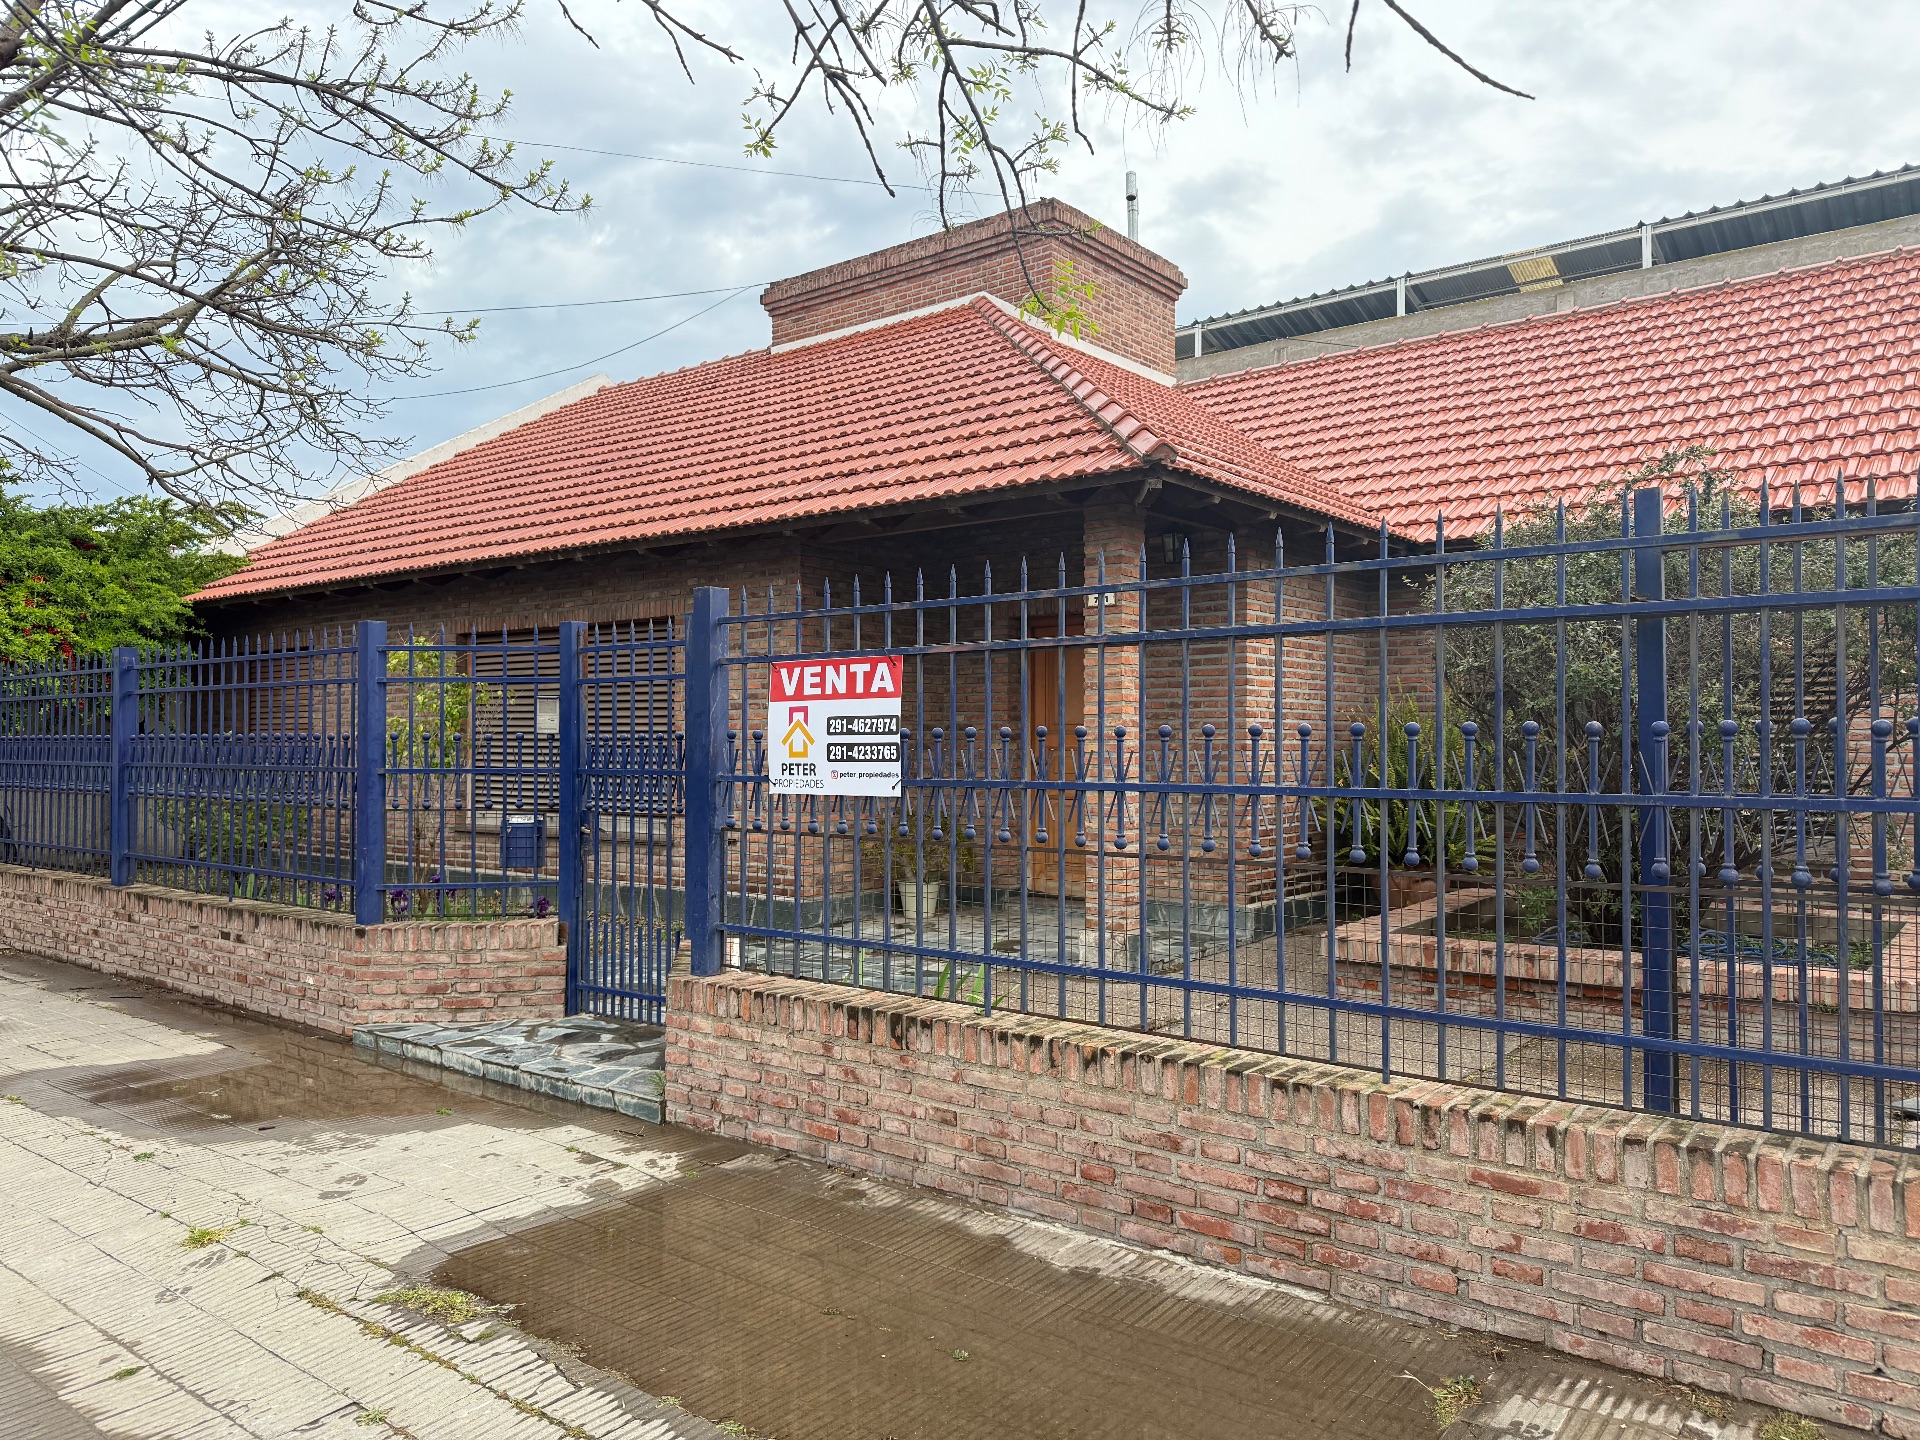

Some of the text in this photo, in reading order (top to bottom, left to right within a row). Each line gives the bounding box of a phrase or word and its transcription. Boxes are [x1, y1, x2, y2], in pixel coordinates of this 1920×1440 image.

[780, 662, 895, 696] VENTA
[829, 718, 897, 733] 291-4627974
[829, 745, 897, 760] 291-4233765
[781, 763, 817, 777] PETER
[774, 779, 825, 789] PROPEDADES
